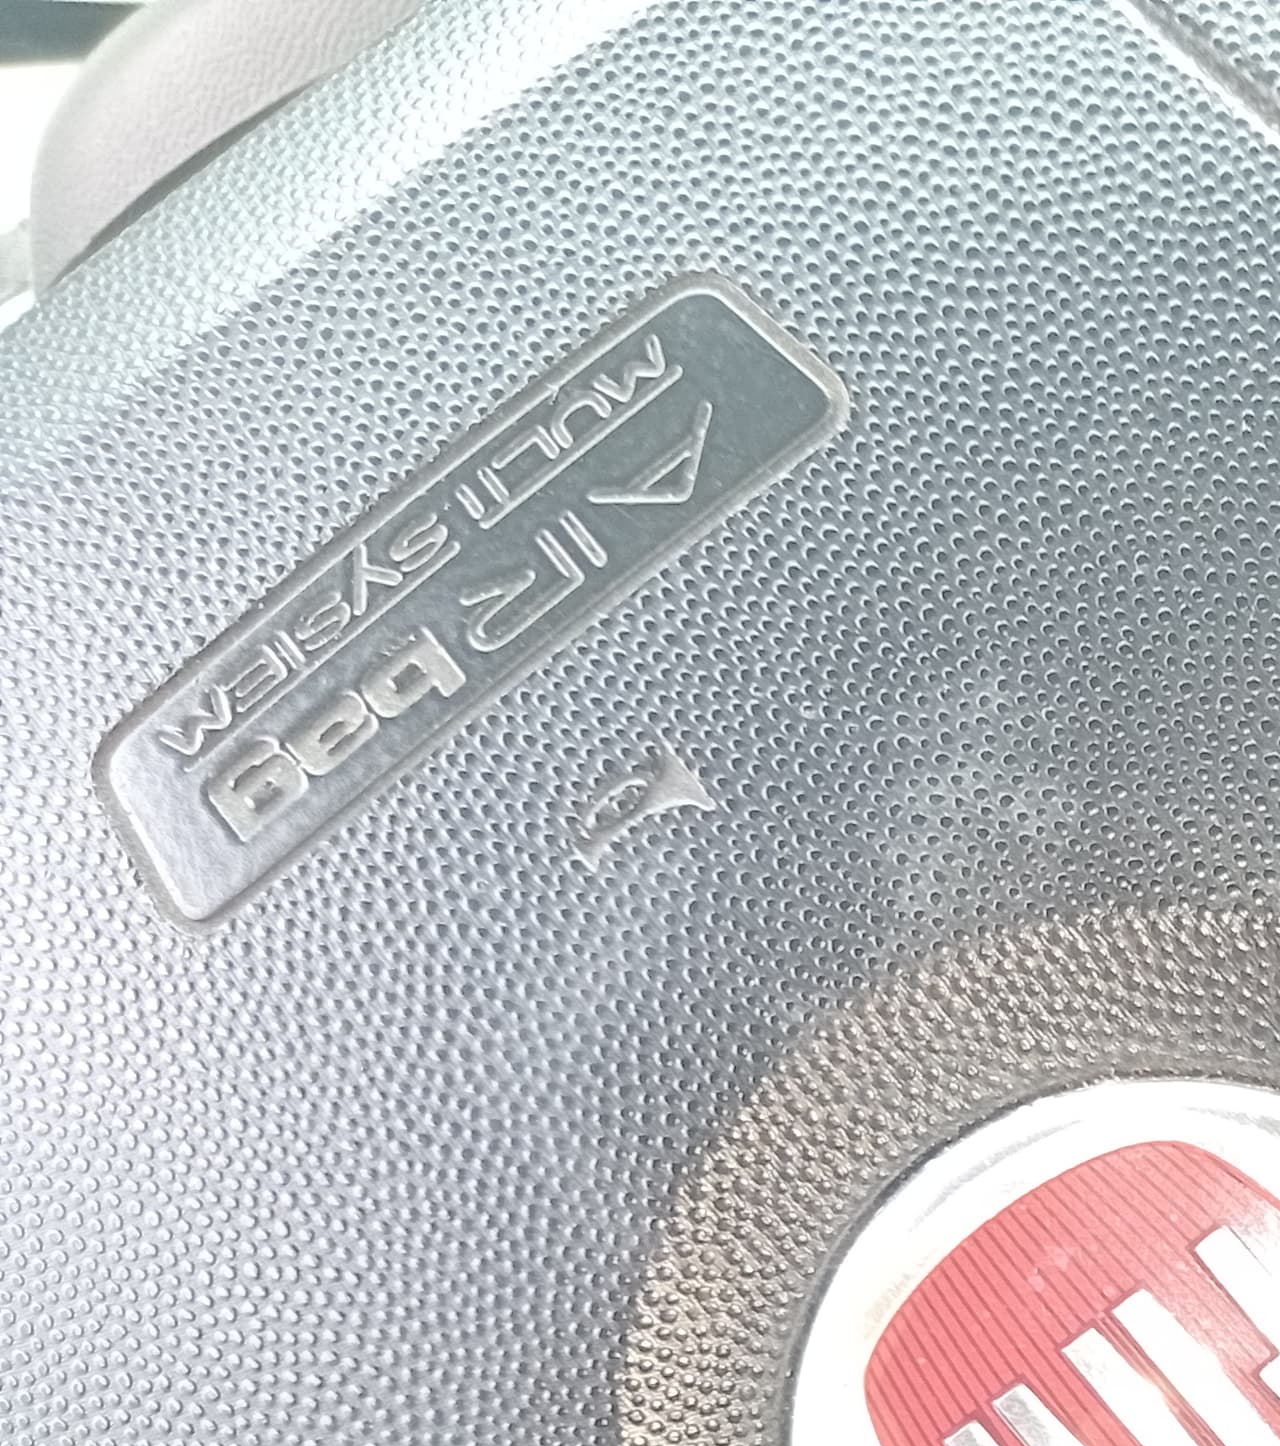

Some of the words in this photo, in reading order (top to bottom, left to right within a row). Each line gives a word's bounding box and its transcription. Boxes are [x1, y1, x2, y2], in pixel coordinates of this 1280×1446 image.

[455, 333, 683, 530] MULTI
[460, 402, 713, 653] AIR
[156, 511, 460, 771] SYSTEM
[207, 626, 466, 842] bag
